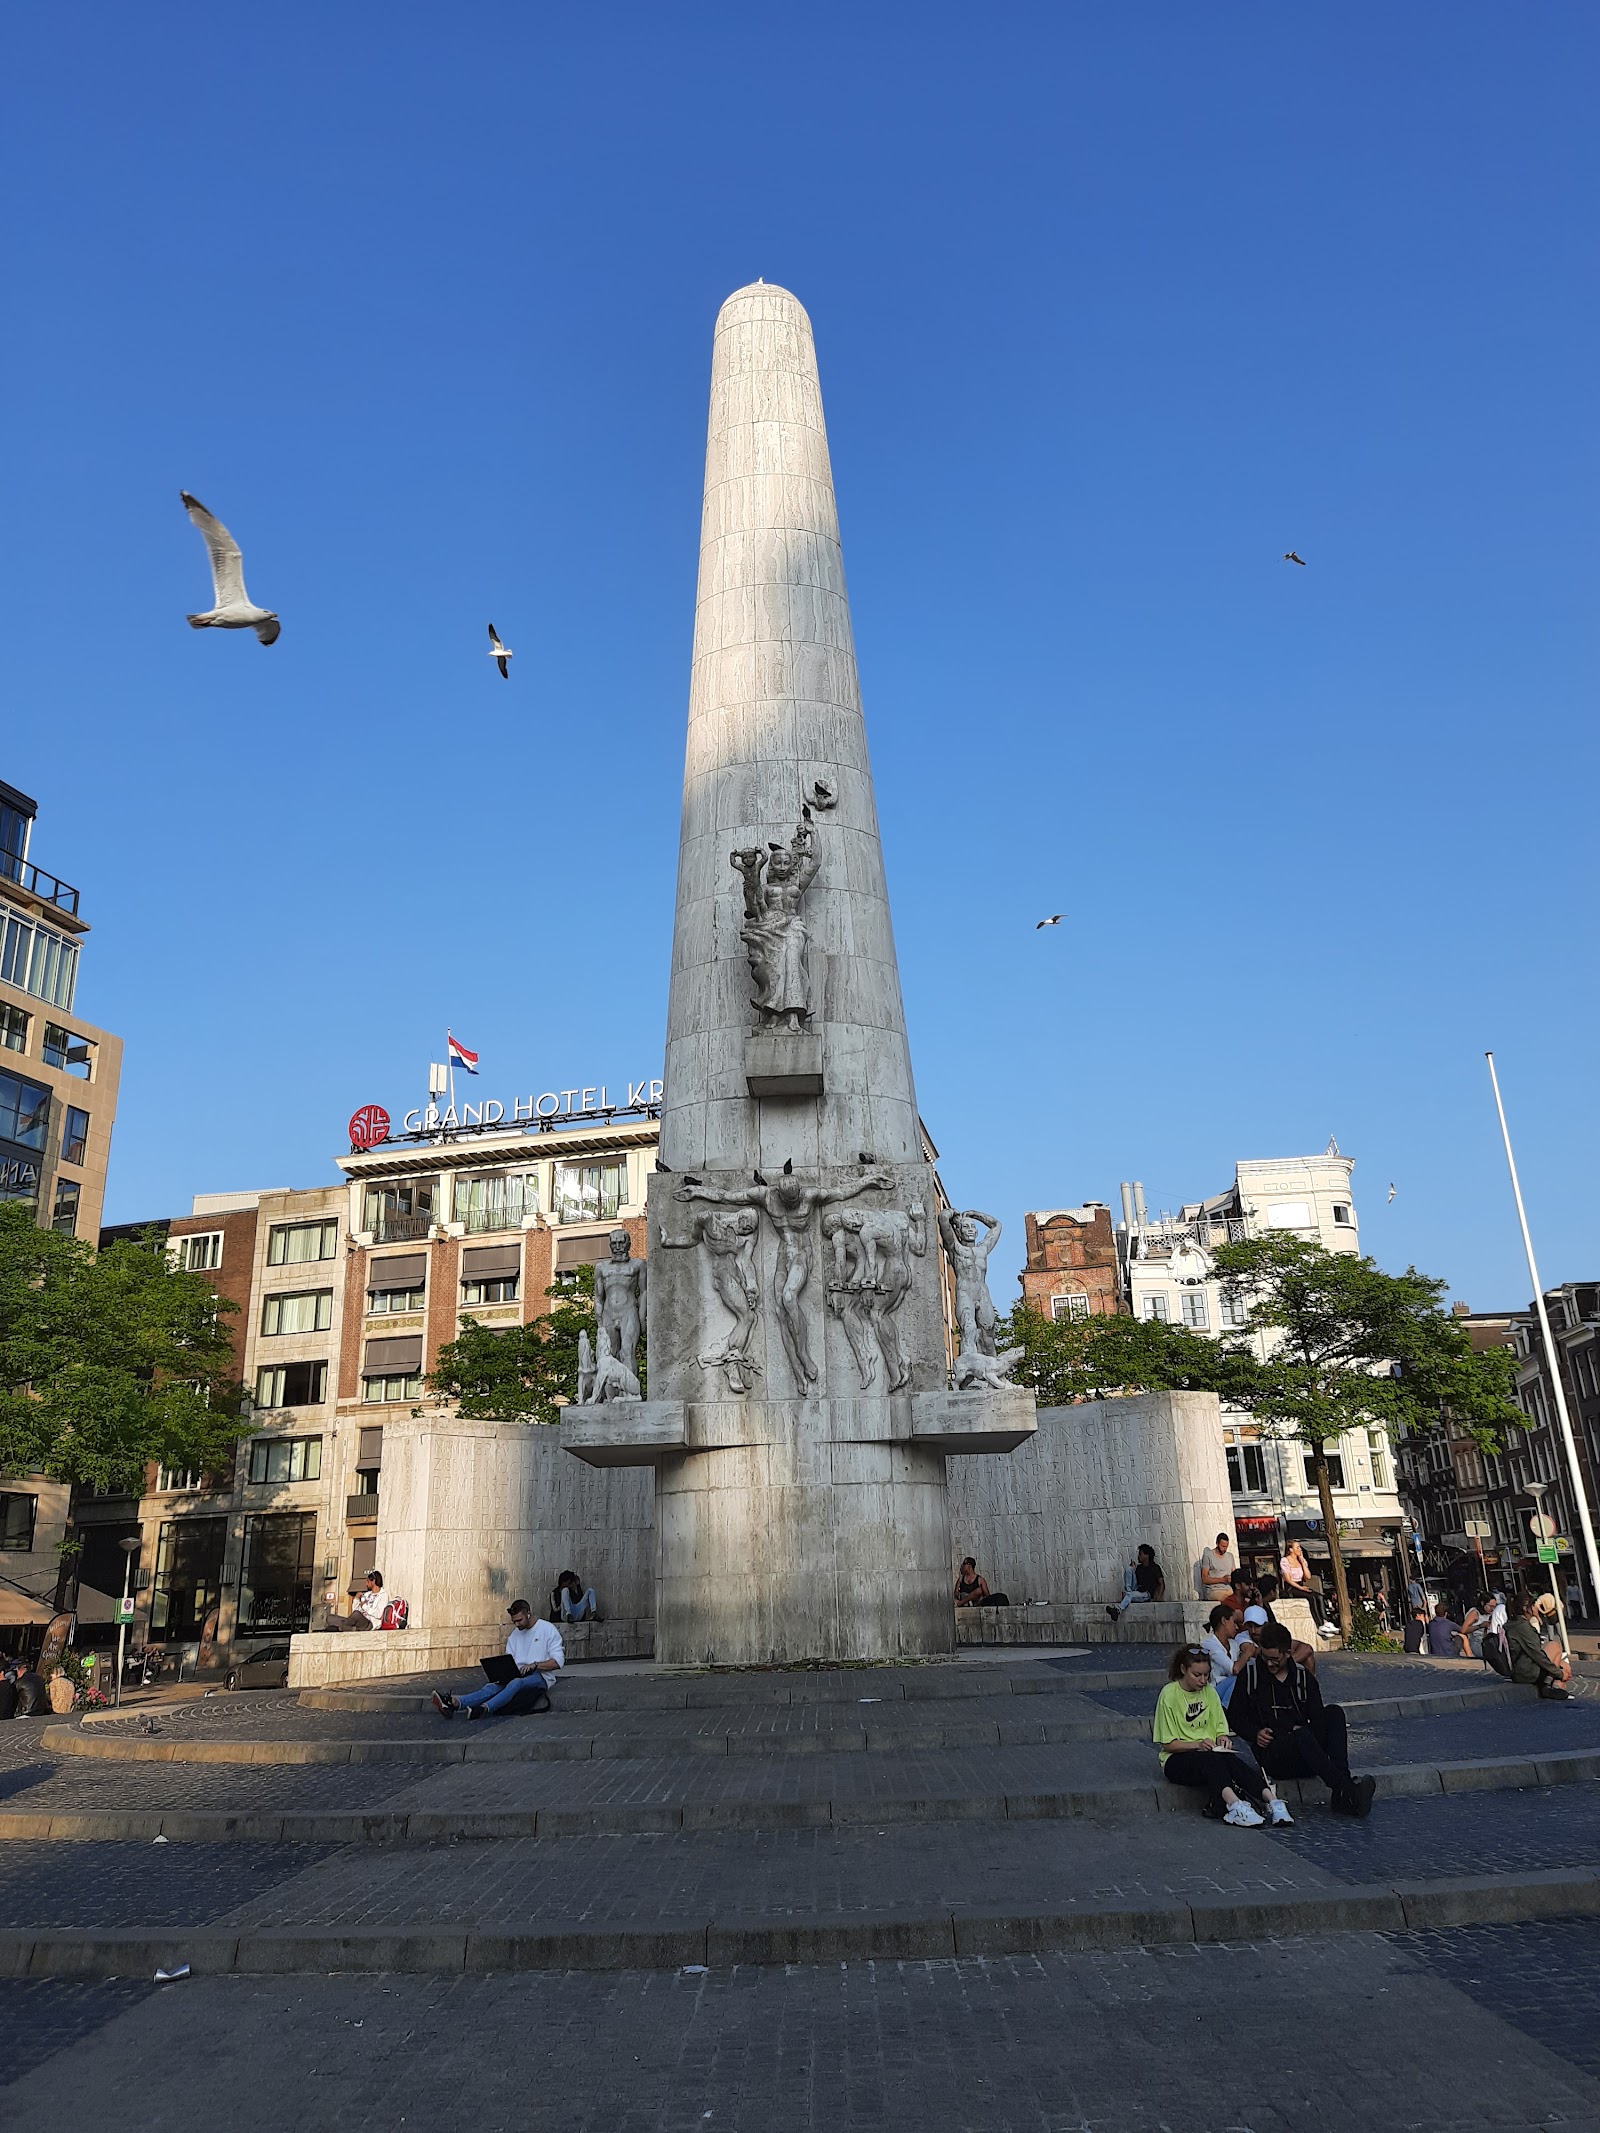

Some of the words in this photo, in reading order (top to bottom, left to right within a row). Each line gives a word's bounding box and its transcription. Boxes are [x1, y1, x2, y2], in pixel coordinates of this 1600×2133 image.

[403, 1100, 504, 1133] GRAND
[514, 1086, 616, 1121] HOTEL
[1026, 1426, 1055, 1443] ON
[1060, 1422, 1106, 1439] NOCH
[1111, 1419, 1132, 1434] DE
[1138, 1414, 1170, 1431] ZON
[1024, 1445, 1045, 1460] DE
[1052, 1437, 1131, 1458] GESLAGEN
[1138, 1432, 1172, 1448] BRES
[484, 1460, 532, 1476] NOCH
[539, 1462, 559, 1476] DE
[1092, 1454, 1136, 1471] HOGE
[432, 1475, 451, 1491] DE
[544, 1480, 572, 1494] DIE
[996, 1477, 1066, 1496] VOLKEN
[1073, 1475, 1091, 1490] EN
[1100, 1468, 1176, 1489] STONDEN
[1045, 1491, 1136, 1509] TREURSPEL
[1145, 1485, 1177, 1502] DAT
[1052, 1510, 1107, 1527] BOVEN
[1150, 1504, 1181, 1521] DAK
[1319, 1518, 1364, 1531] Bvaria
[429, 1531, 492, 1549] WERELD
[1011, 1532, 1044, 1547] ONS
[1082, 1525, 1152, 1544] VERLOST
[1160, 1522, 1183, 1539] ALS
[428, 1551, 470, 1567] GEEN
[428, 1567, 451, 1588] WIJ
[427, 1586, 477, 1605] ENKEL
